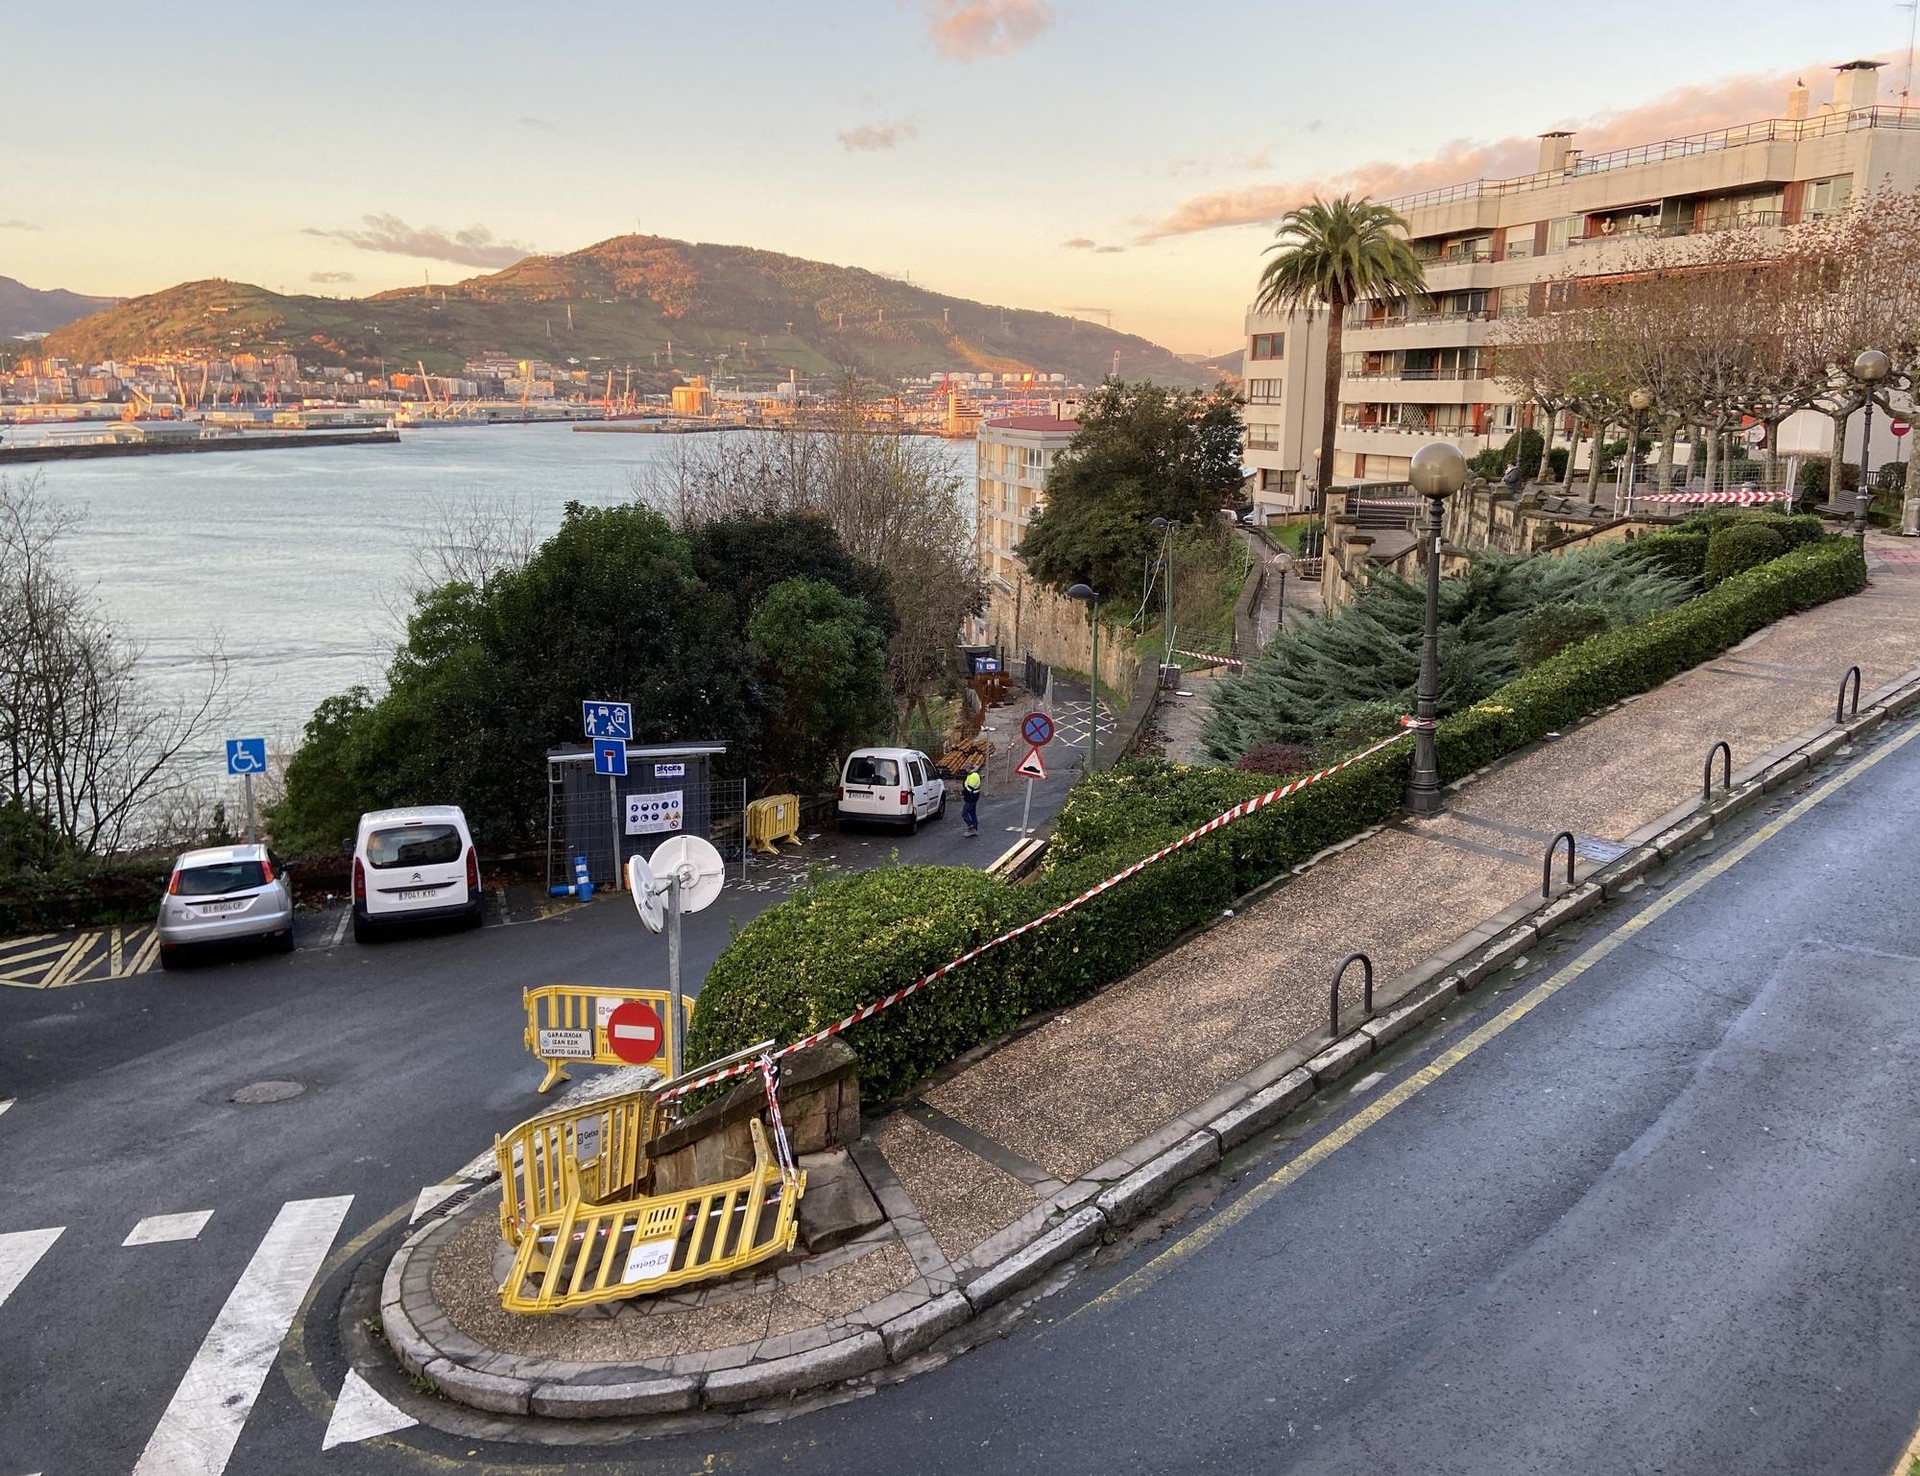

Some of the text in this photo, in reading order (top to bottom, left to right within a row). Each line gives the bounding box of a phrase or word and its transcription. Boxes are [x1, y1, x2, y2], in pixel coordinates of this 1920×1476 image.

[541, 1047, 591, 1056] EXCEPTO GARAJES
[584, 1129, 599, 1140] Getxo
[629, 1259, 656, 1271] Getxo
